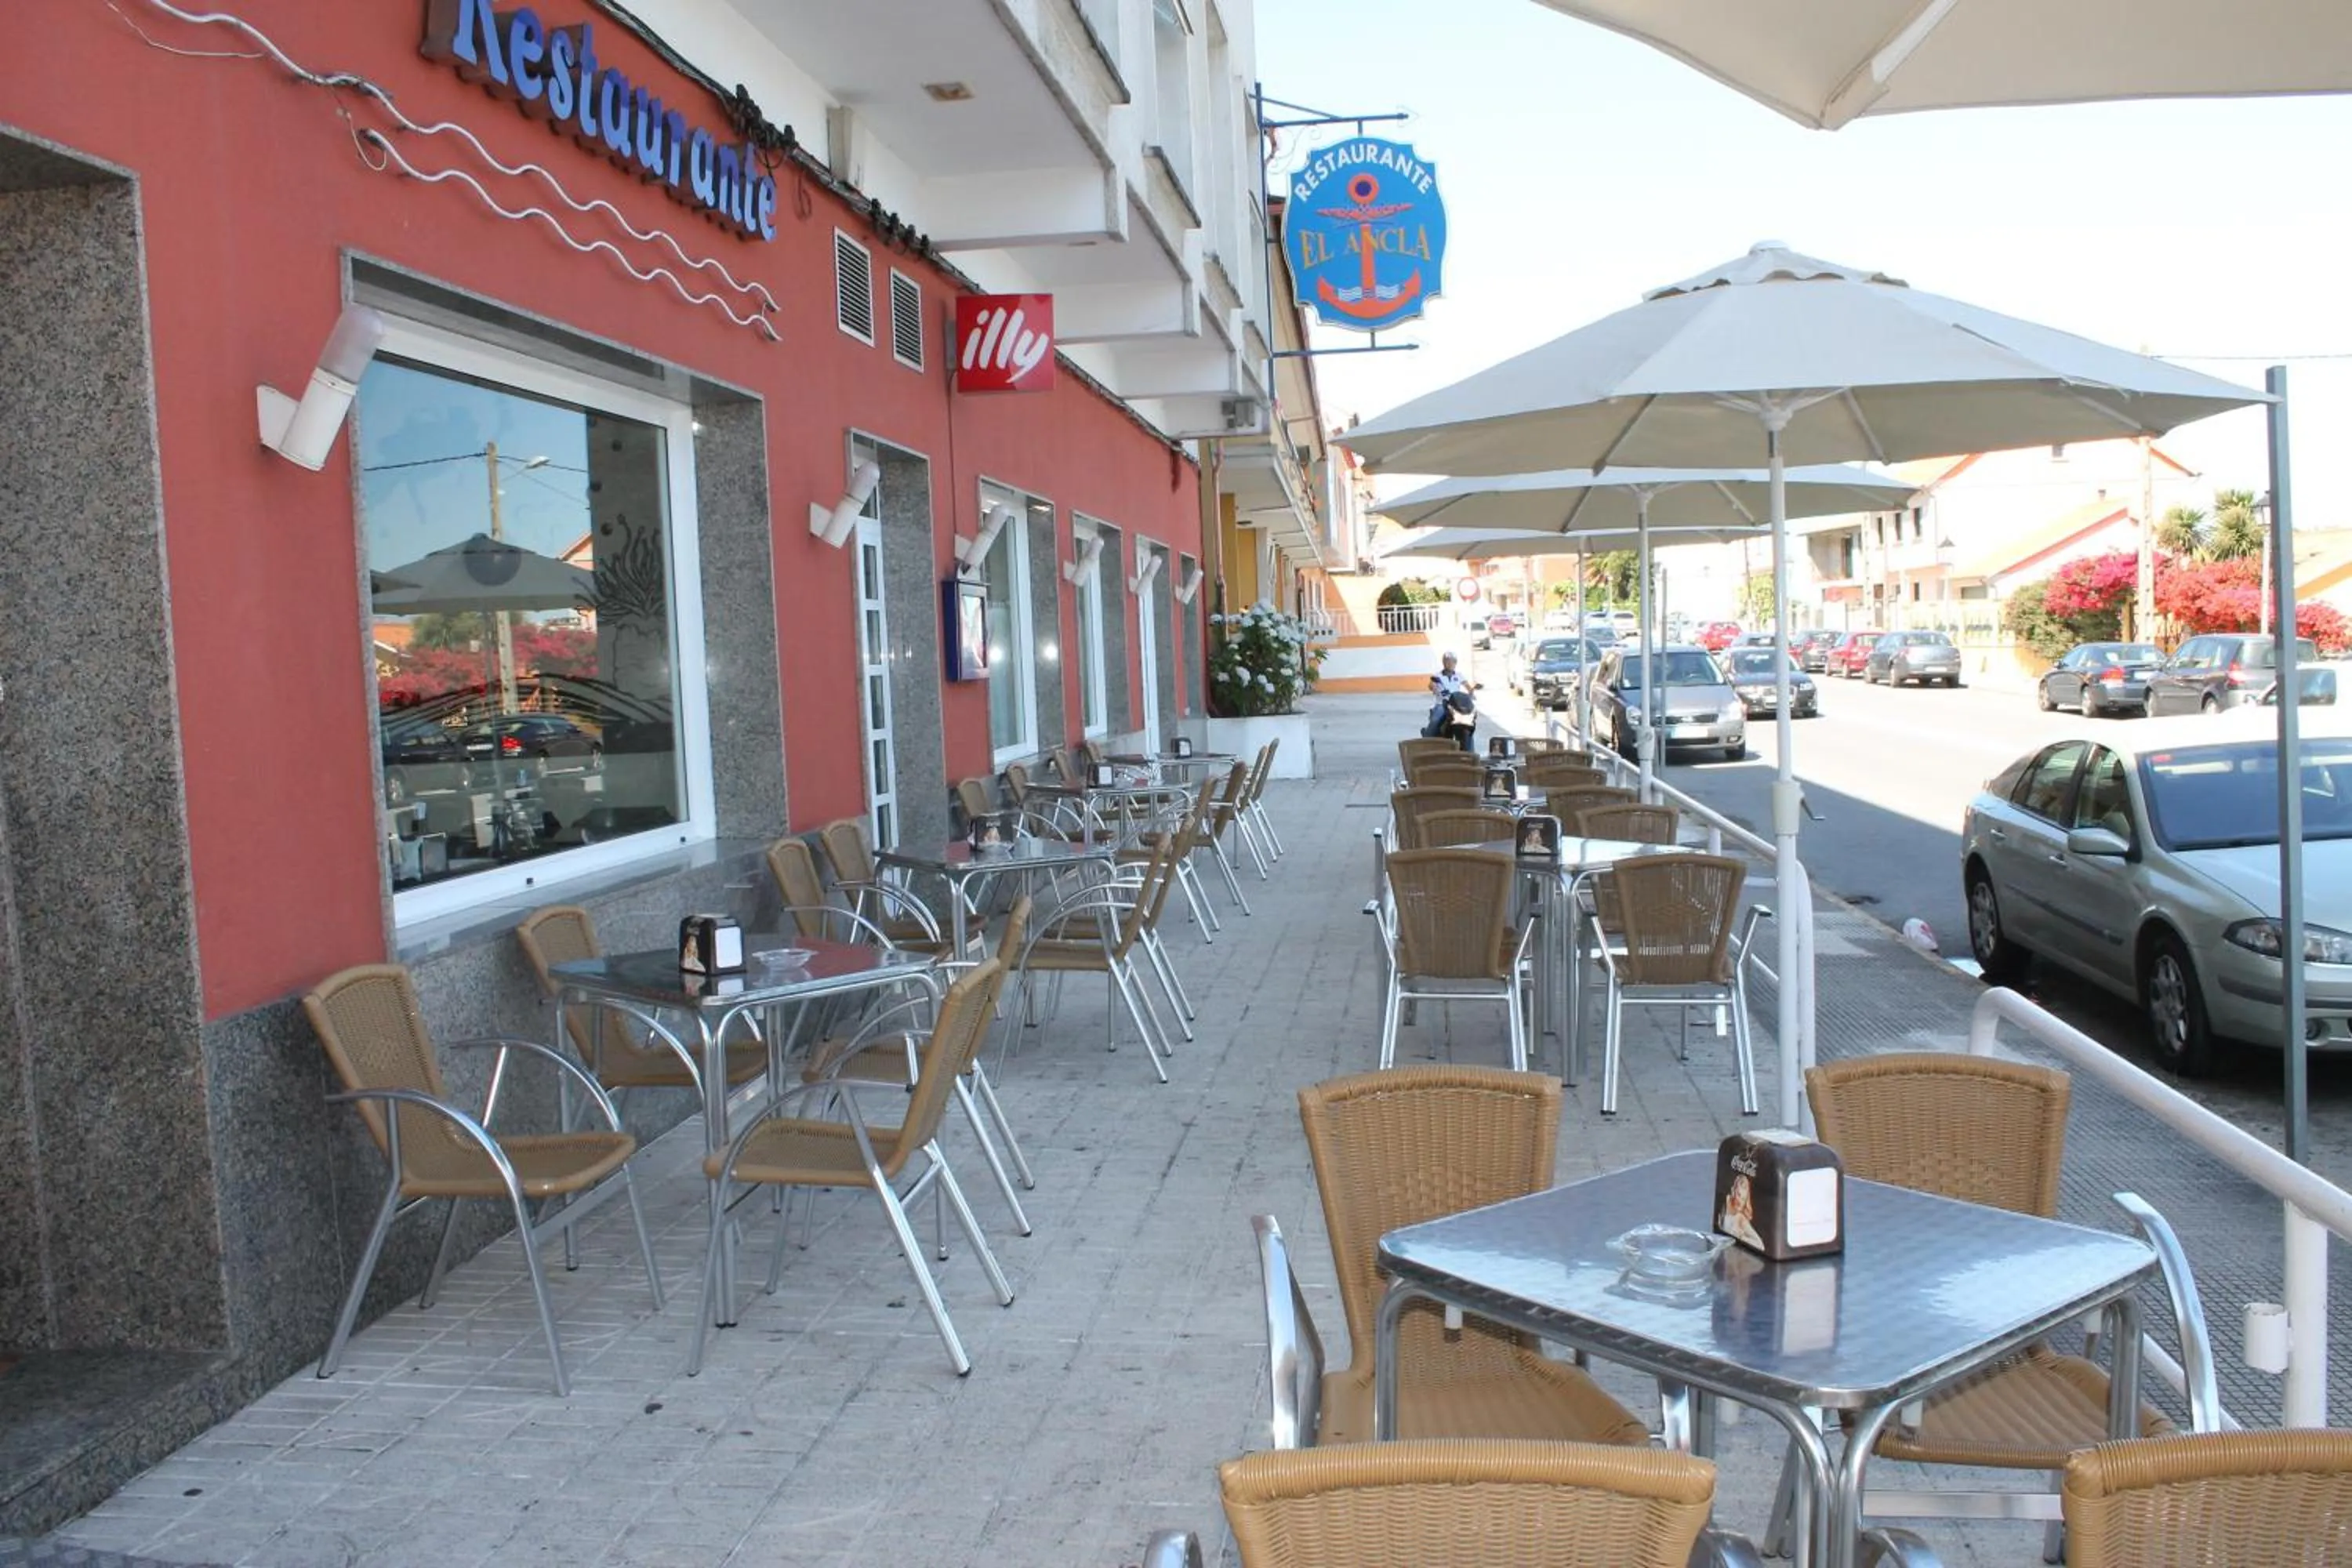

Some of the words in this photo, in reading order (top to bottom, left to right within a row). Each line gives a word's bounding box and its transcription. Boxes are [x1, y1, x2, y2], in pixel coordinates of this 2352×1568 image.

[1294, 143, 1432, 201] RESTAURANTE
[1299, 229, 1333, 270] EL
[1344, 223, 1431, 261] ANCLA
[962, 307, 1050, 383] illy
